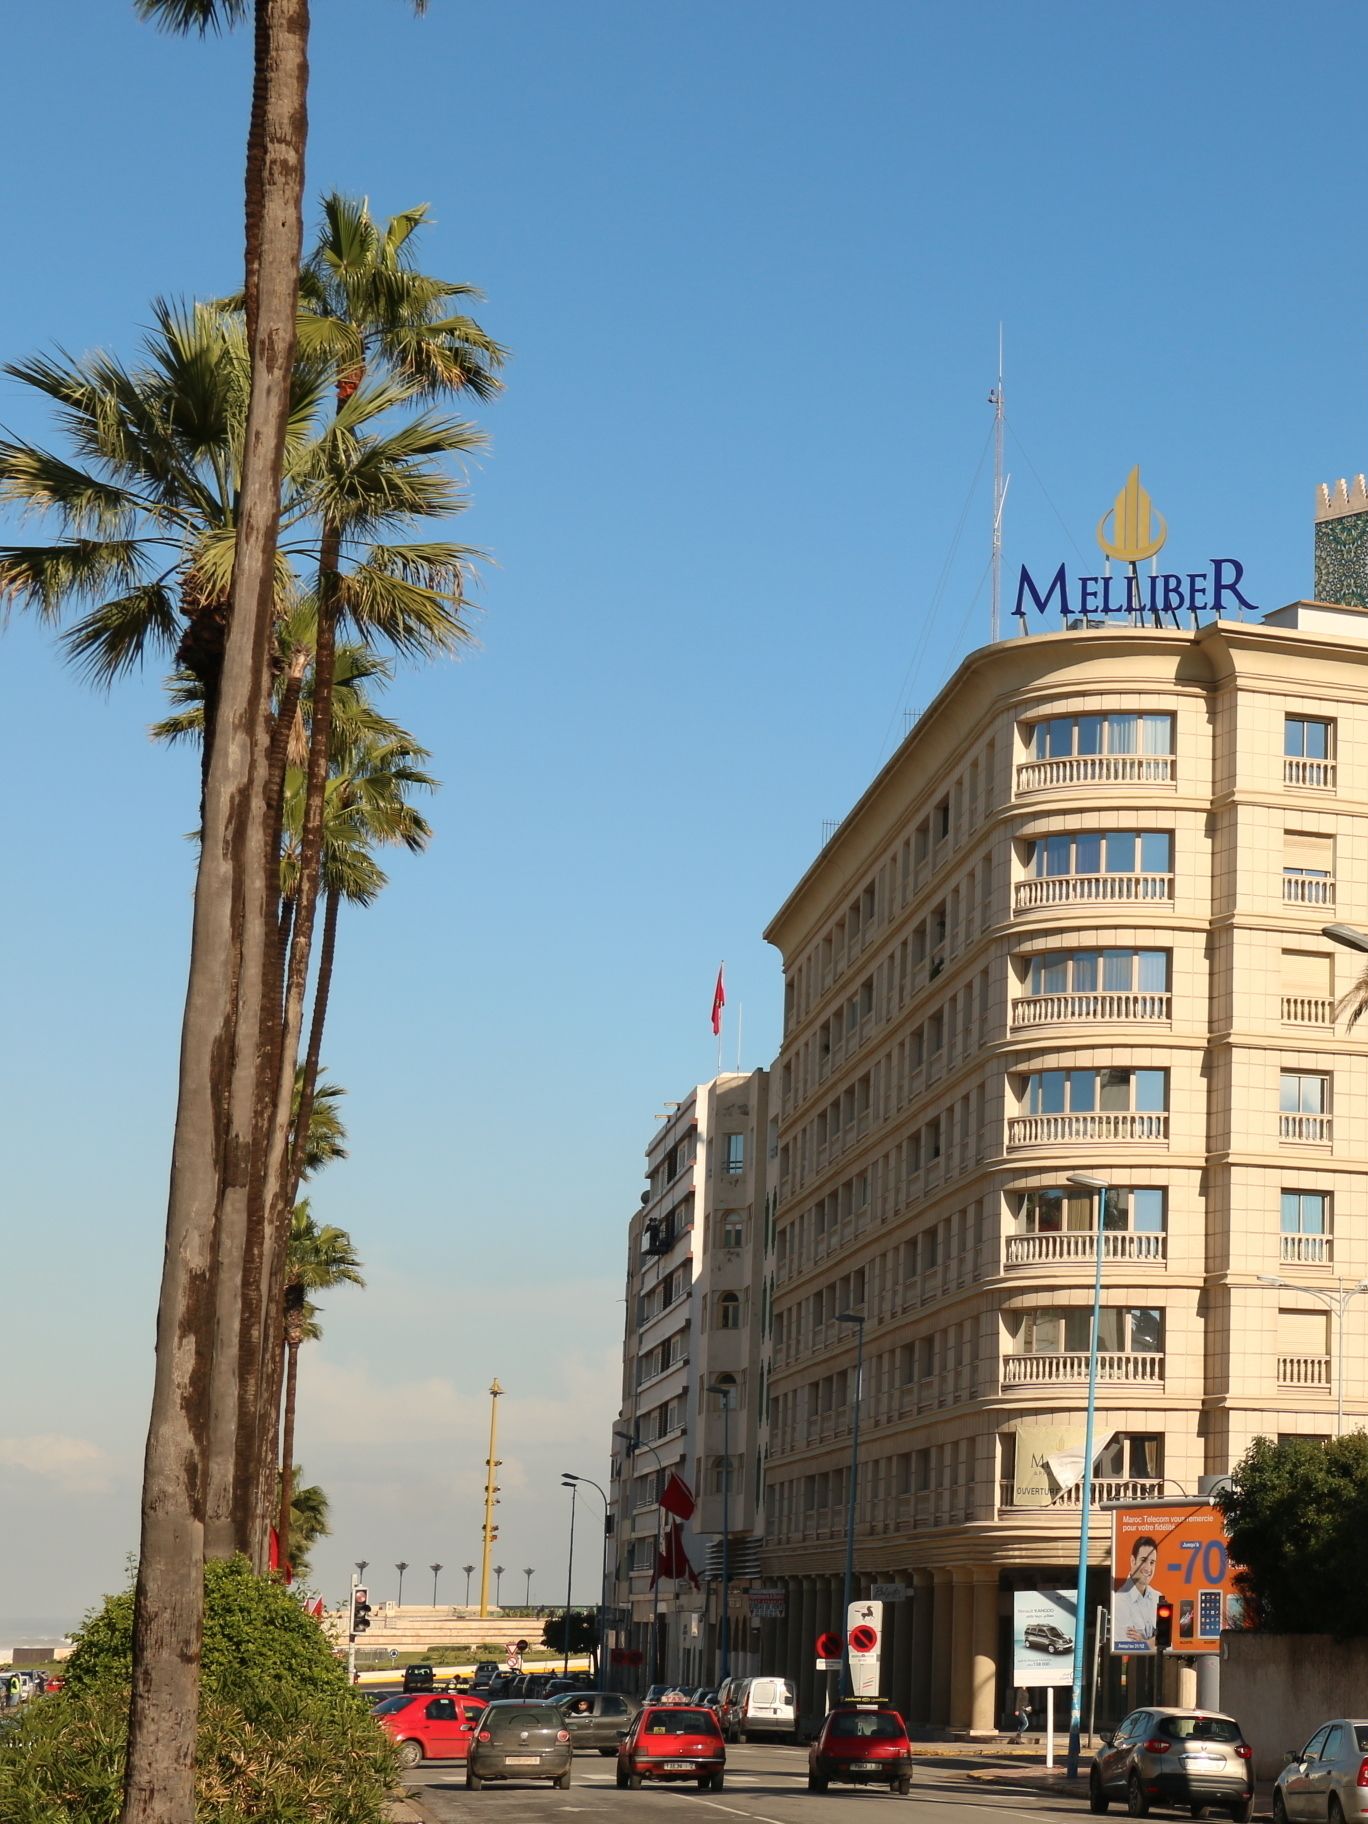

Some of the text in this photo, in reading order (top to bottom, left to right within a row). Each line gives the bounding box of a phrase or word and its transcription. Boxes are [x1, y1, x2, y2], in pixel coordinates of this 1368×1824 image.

[1011, 558, 1259, 615] MELLIBER
[1122, 1515, 1142, 1523] Maroc
[1143, 1515, 1170, 1523] Telecom
[1122, 1525, 1137, 1533] pour
[1138, 1524, 1153, 1532] votre
